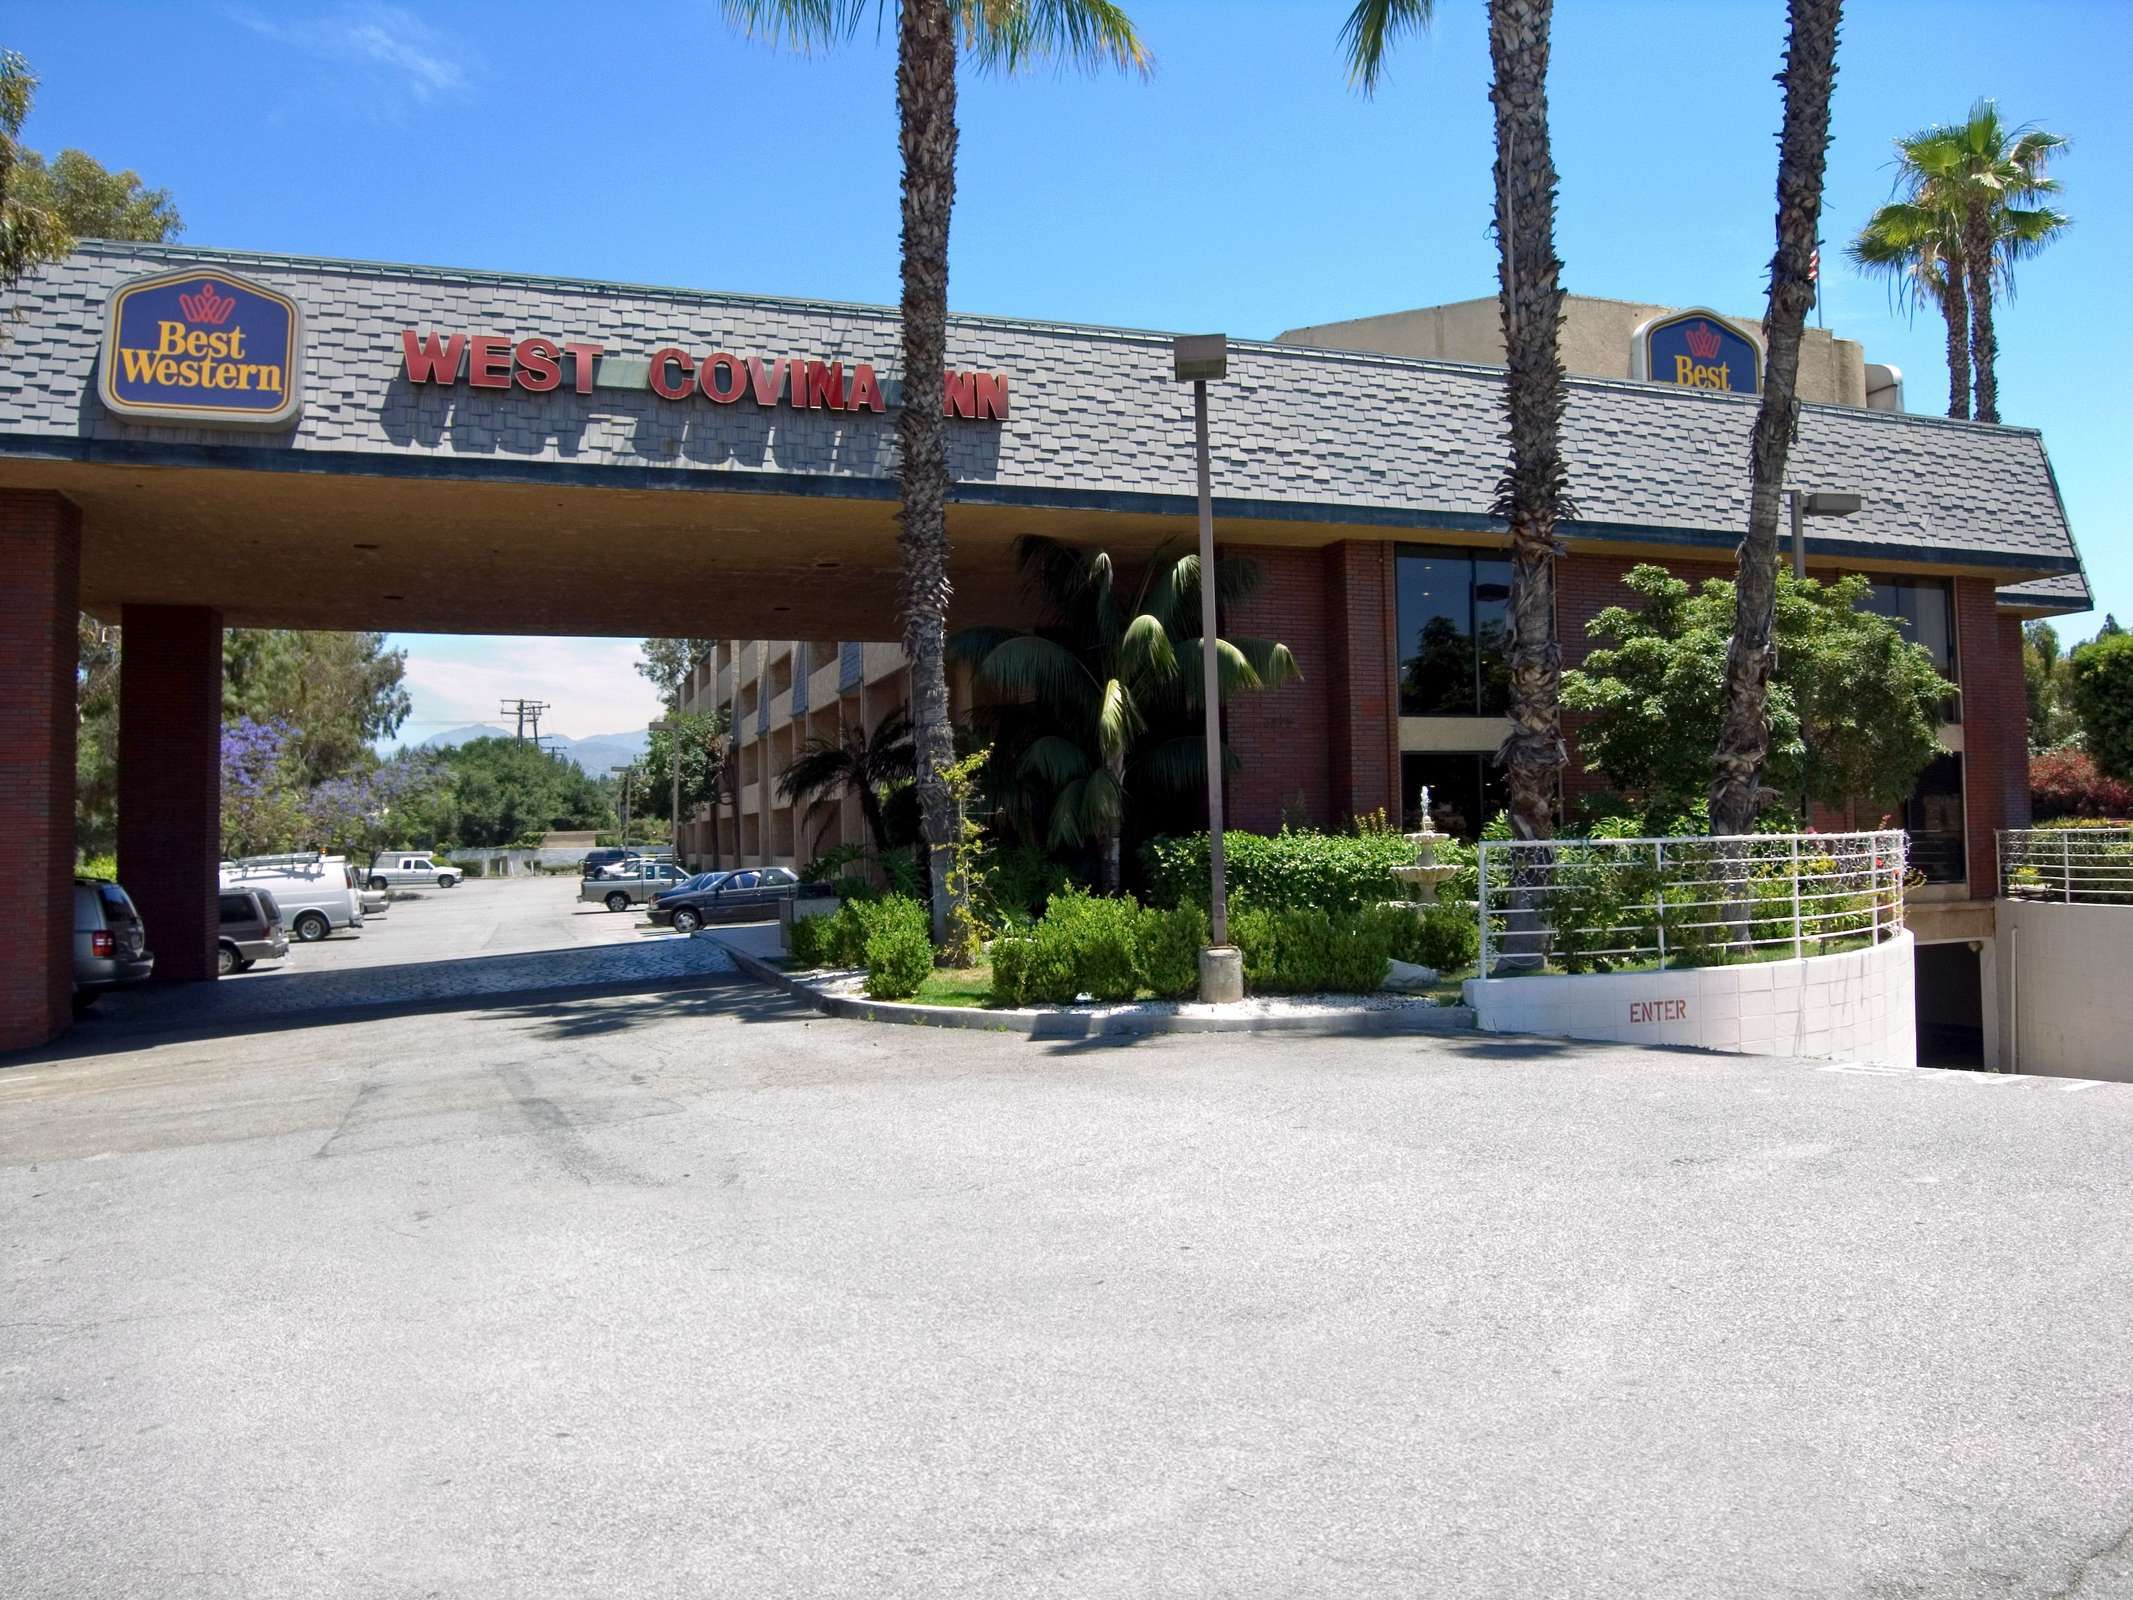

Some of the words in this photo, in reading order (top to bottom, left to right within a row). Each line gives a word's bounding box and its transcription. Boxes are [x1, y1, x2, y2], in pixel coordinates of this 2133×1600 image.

[158, 320, 246, 360] Best
[120, 348, 282, 393] Western
[401, 329, 604, 394] WEST
[648, 346, 887, 414] COVINA
[943, 369, 1009, 421] NN
[1674, 354, 1730, 391] Best
[1629, 999, 1687, 1023] ENTER
